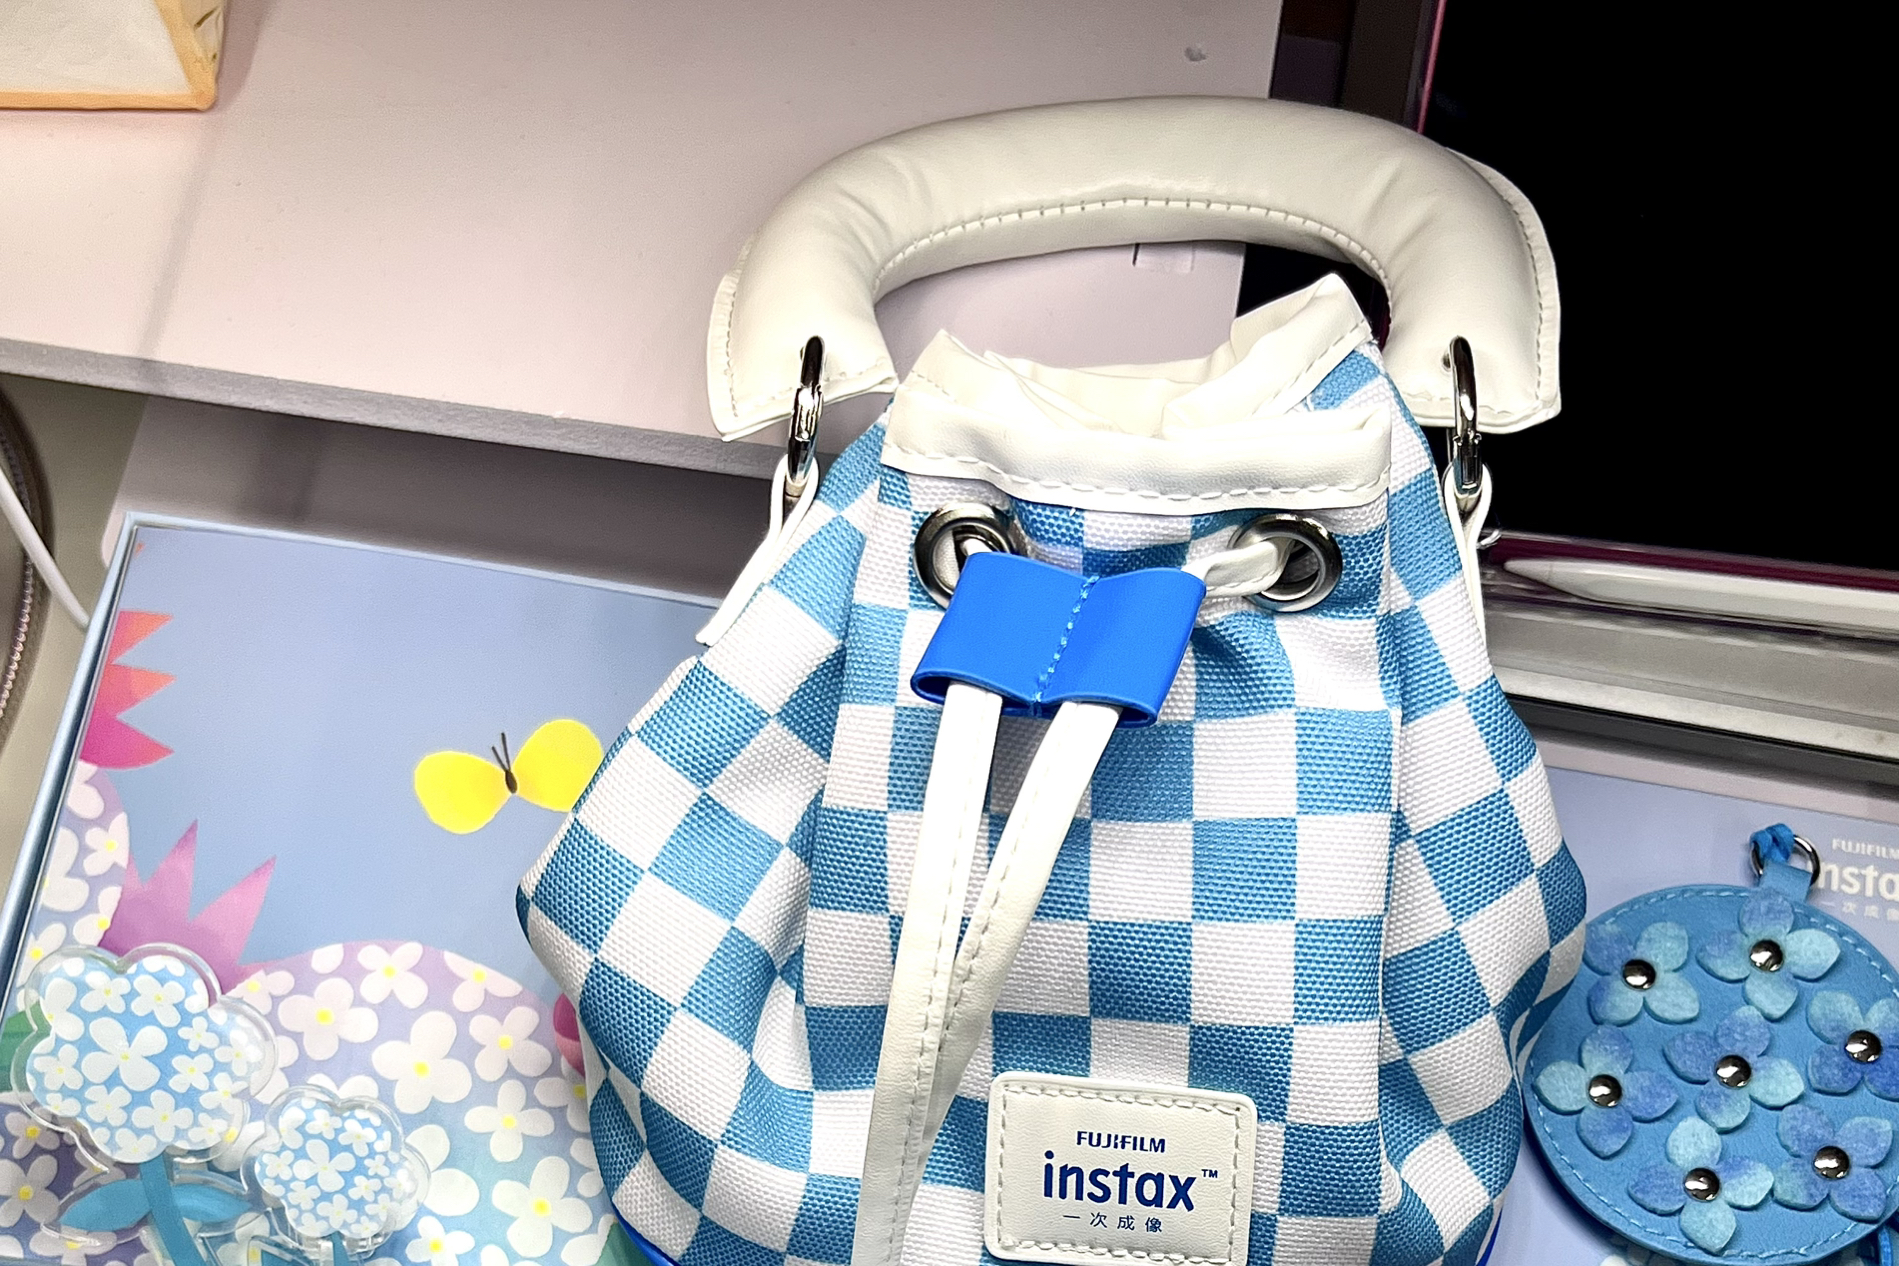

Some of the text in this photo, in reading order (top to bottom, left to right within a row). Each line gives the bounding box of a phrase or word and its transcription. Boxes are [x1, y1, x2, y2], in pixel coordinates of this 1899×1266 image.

[1076, 1131, 1166, 1153] FUJIFILM
[1063, 1212, 1163, 1233] 一次成像
